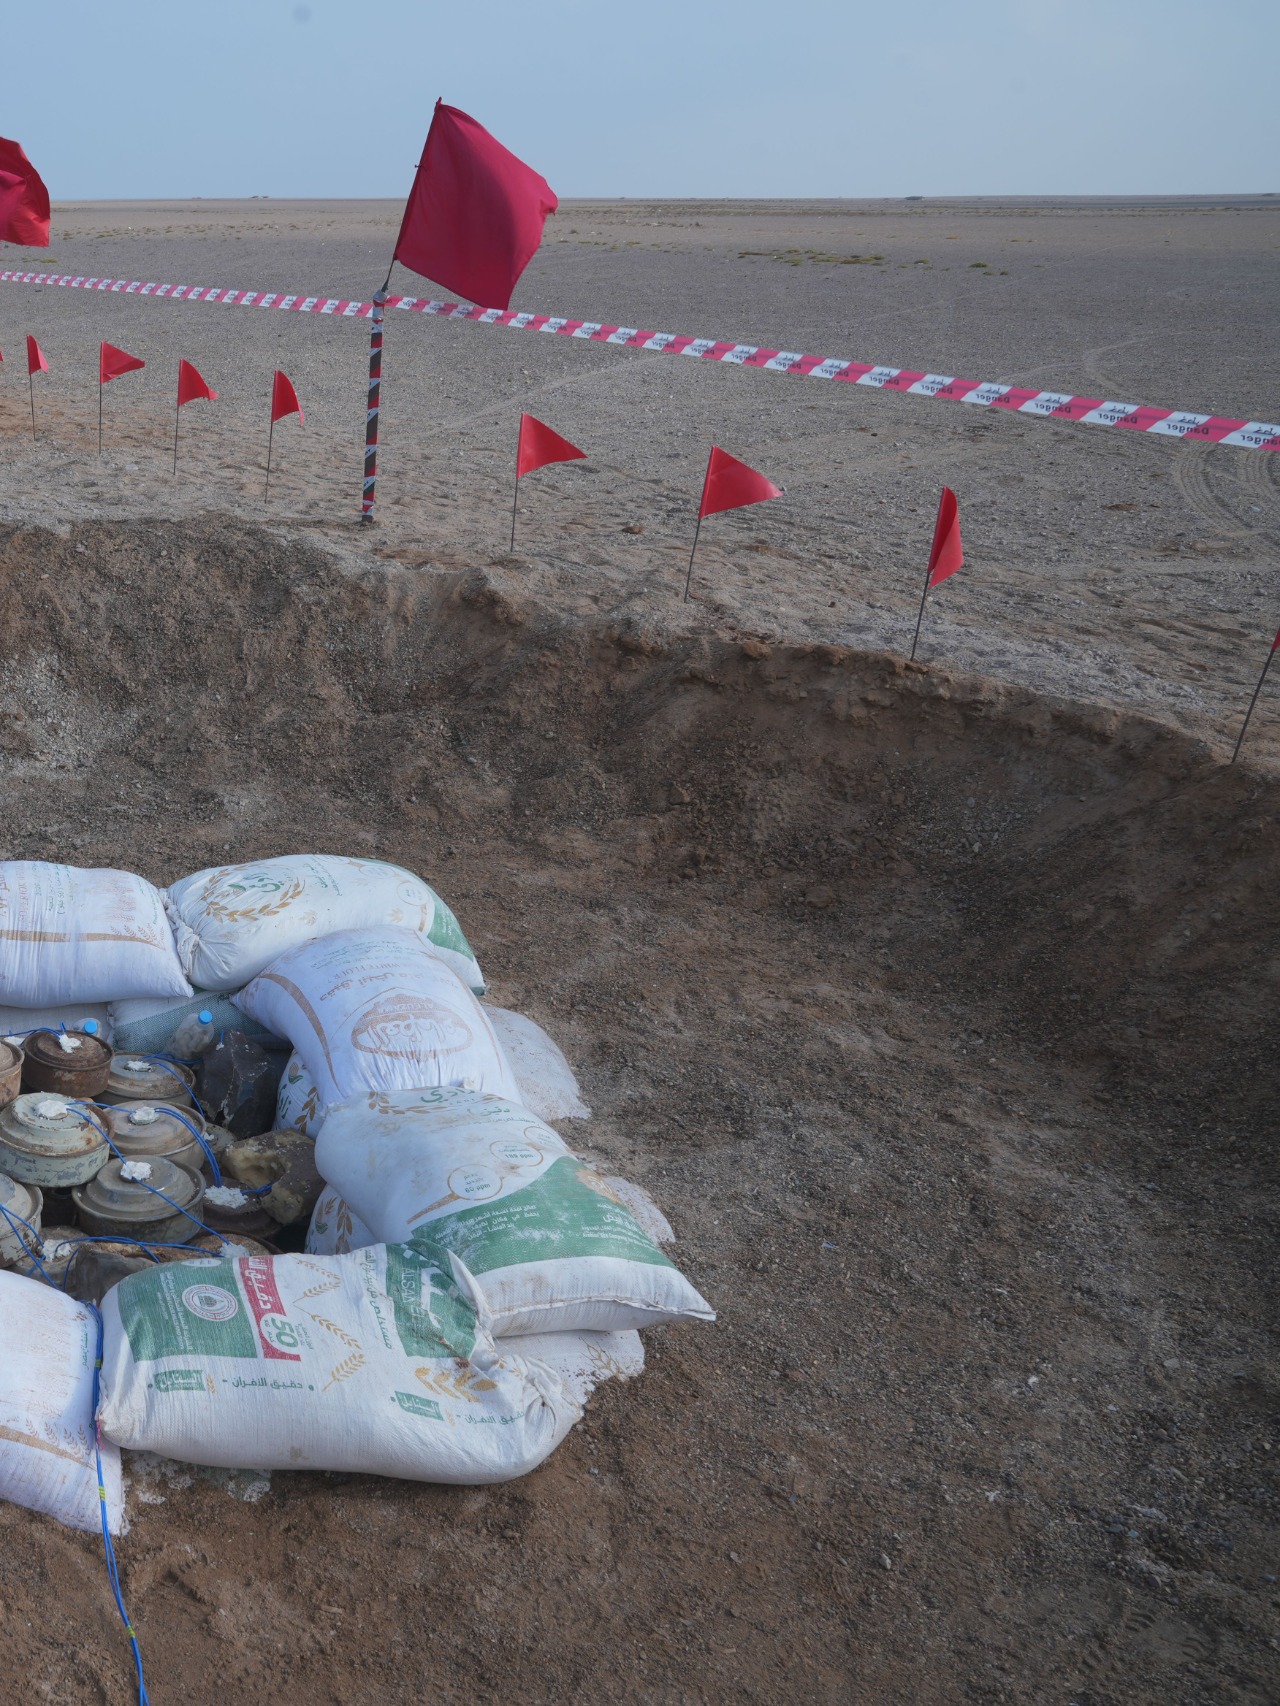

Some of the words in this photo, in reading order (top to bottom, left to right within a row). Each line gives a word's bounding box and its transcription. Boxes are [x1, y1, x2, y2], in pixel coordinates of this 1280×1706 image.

[245, 1269, 271, 1309] دقيق
[271, 1316, 299, 1348] 50
[270, 1380, 303, 1389] دقيق
